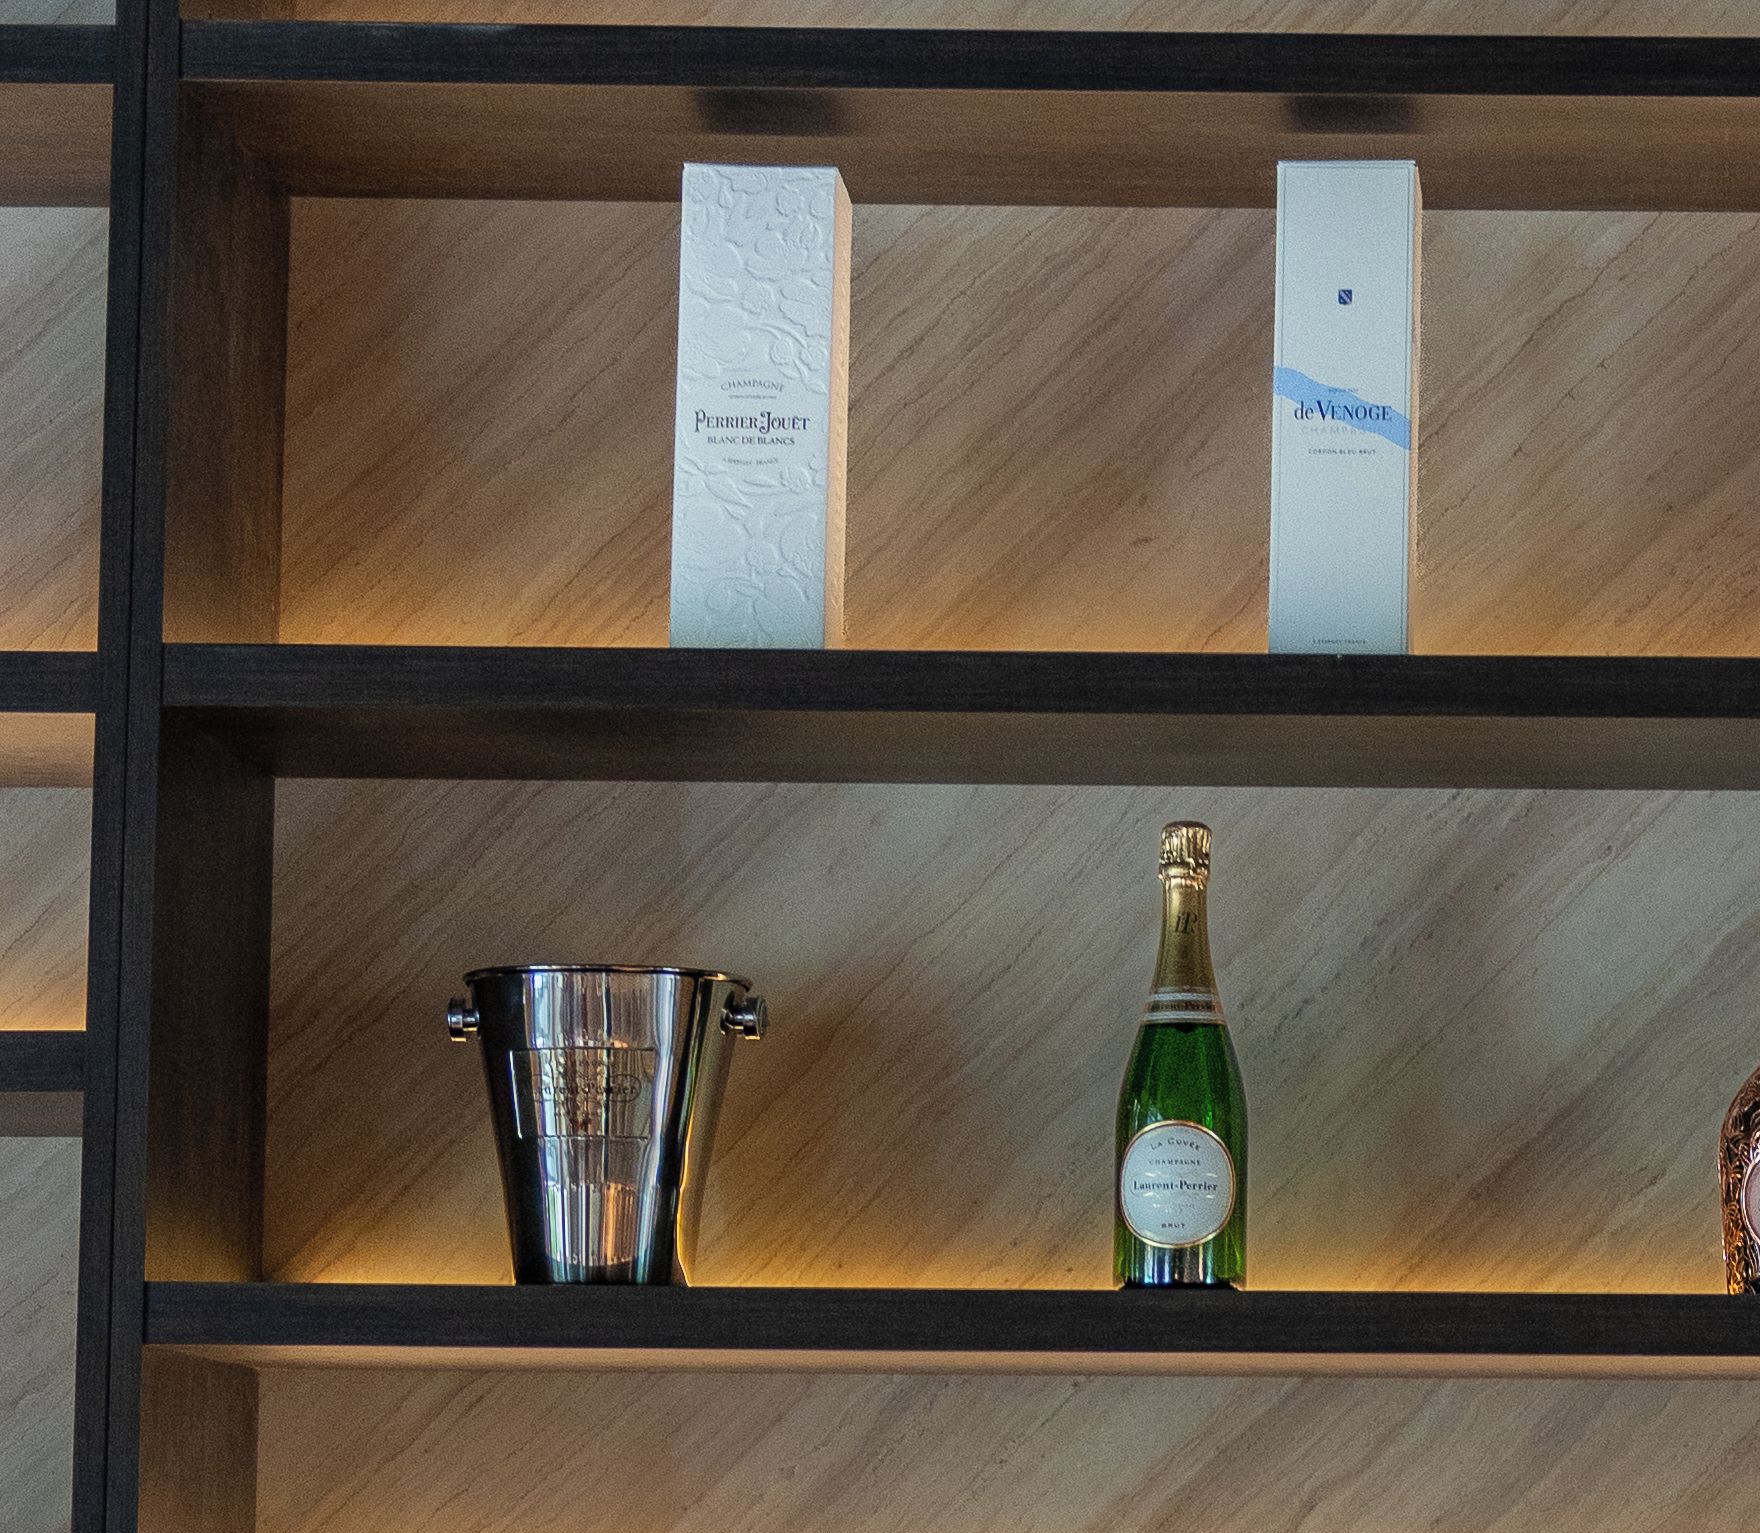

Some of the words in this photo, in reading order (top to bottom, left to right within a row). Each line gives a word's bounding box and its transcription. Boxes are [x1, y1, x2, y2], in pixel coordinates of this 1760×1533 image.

[720, 379, 784, 392] CHAMPAGNE
[1294, 400, 1314, 421] de
[707, 436, 740, 445] BLANC
[742, 437, 757, 445] DE
[758, 437, 796, 446] BLANCS
[1133, 1179, 1219, 1192] Laurent-Perrier
